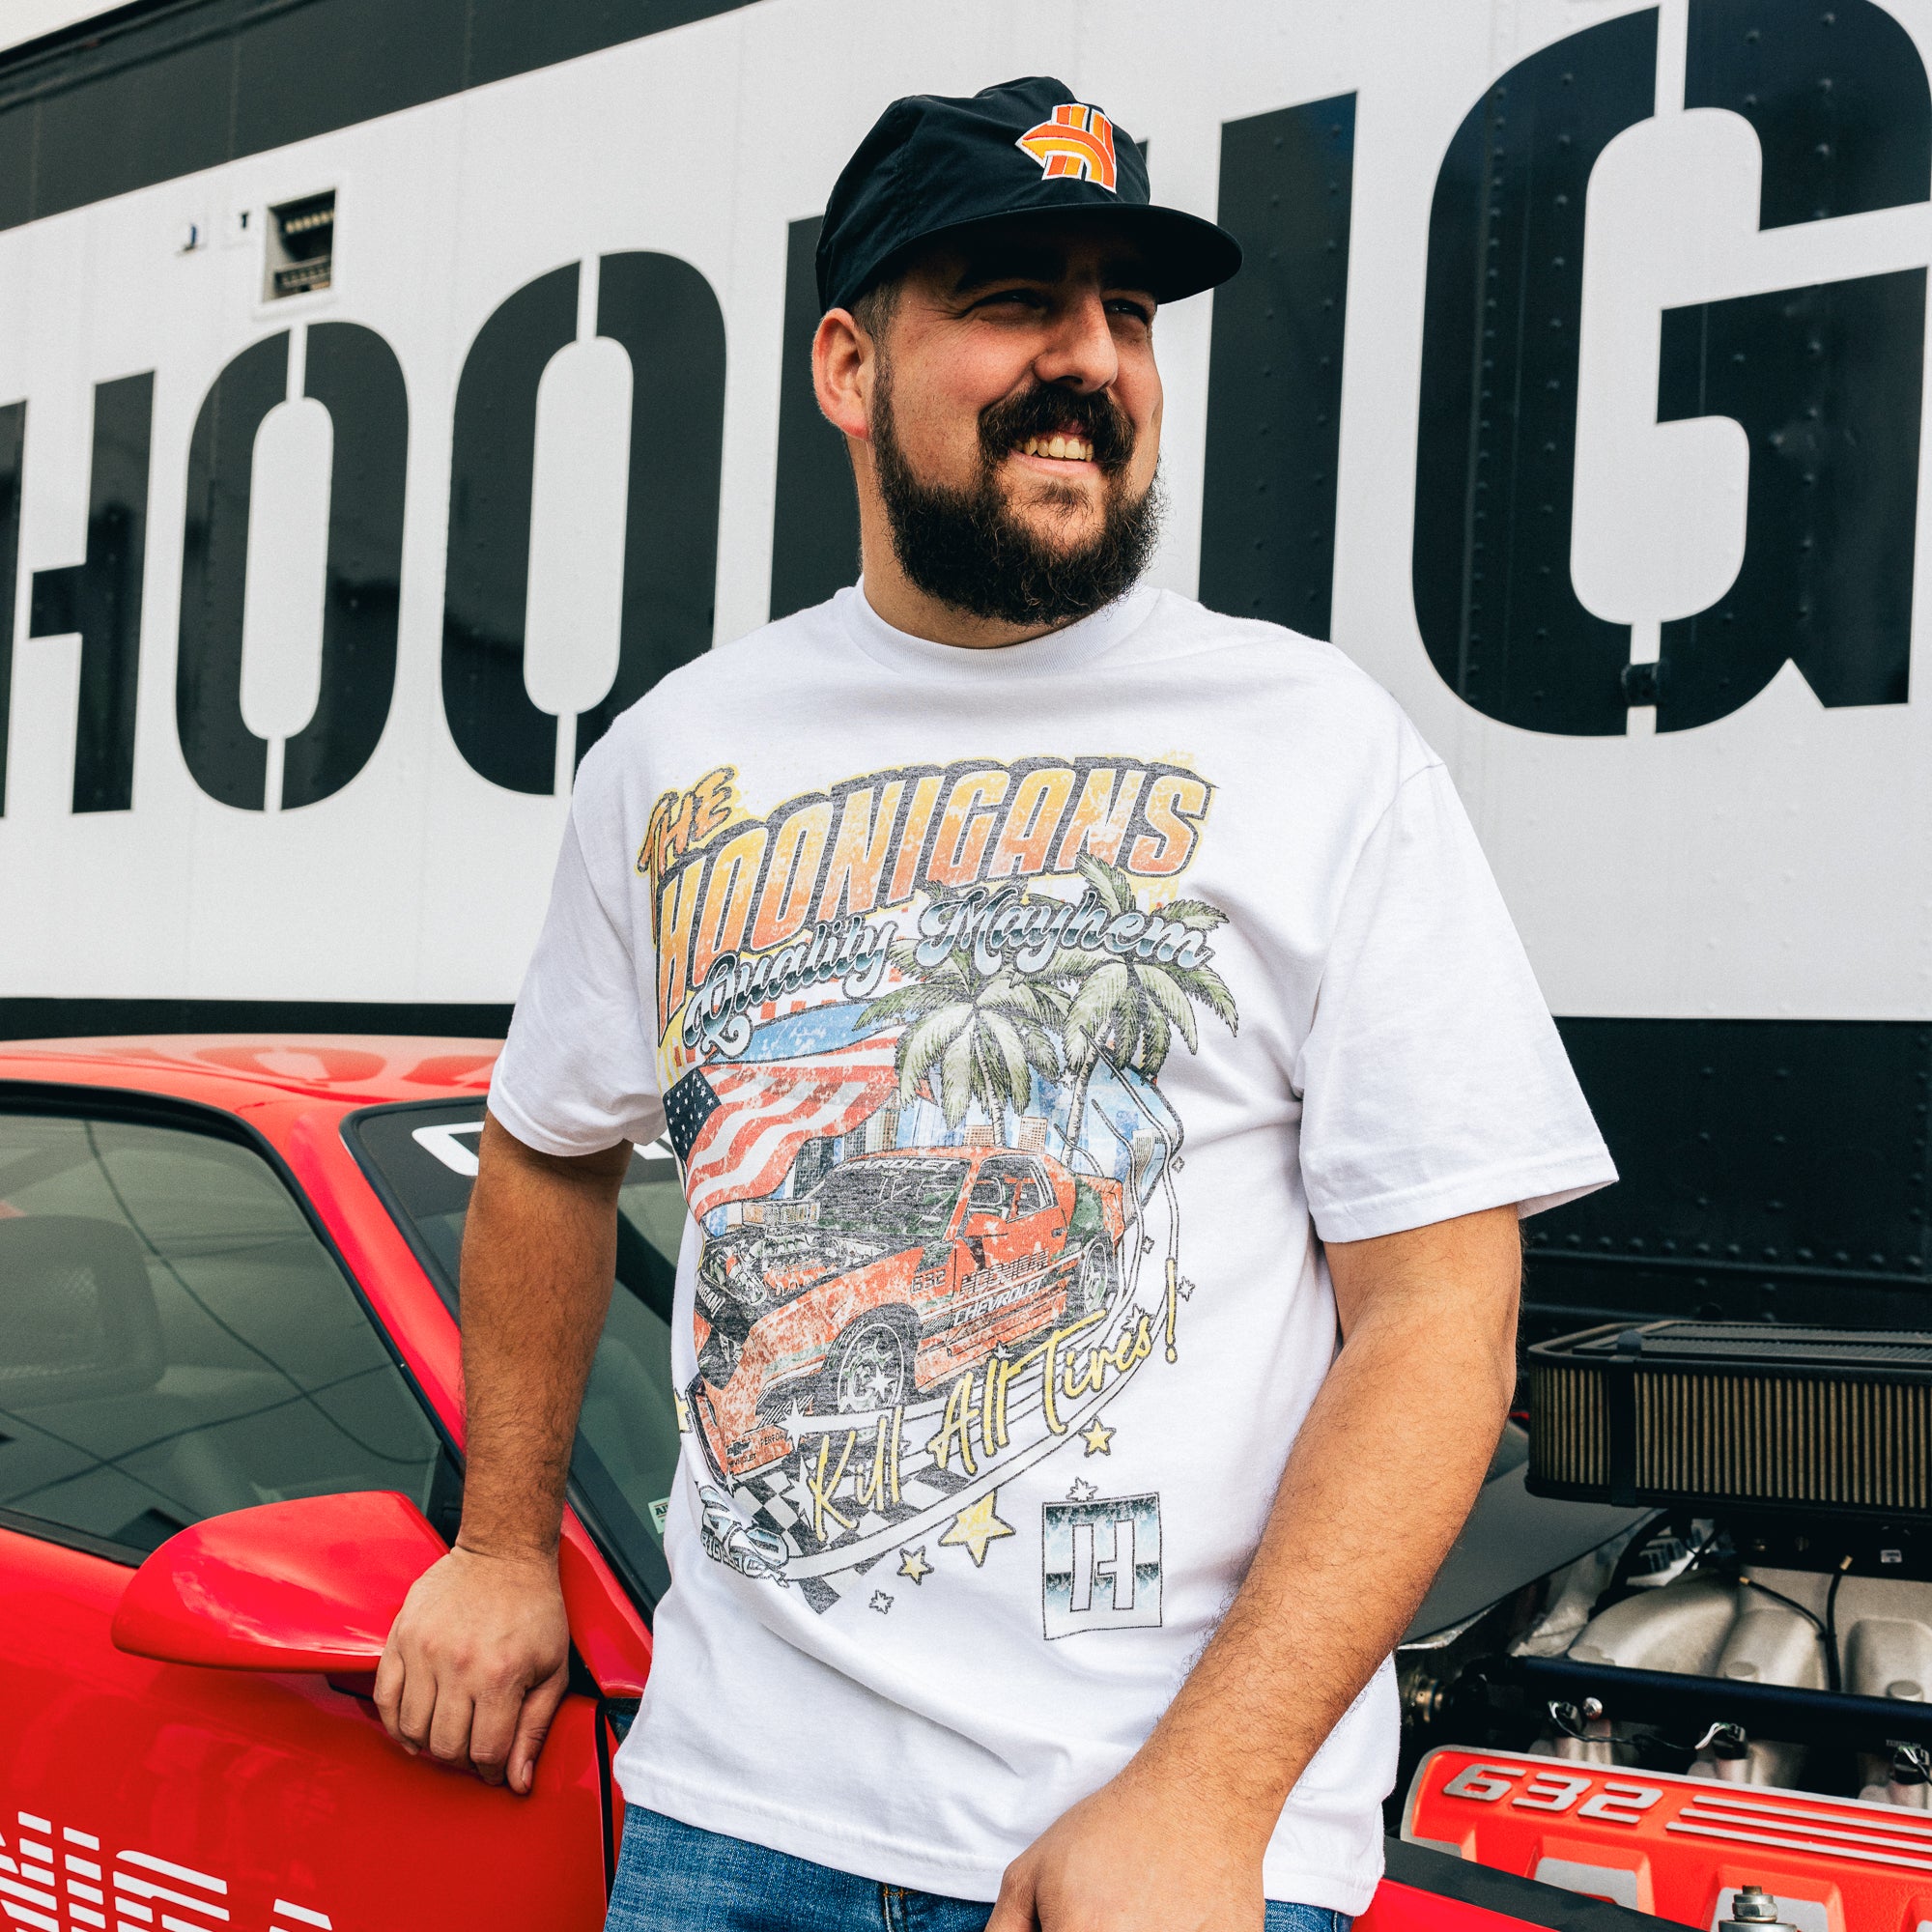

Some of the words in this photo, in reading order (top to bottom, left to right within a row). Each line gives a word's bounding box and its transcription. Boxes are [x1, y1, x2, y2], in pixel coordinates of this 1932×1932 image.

[0, 0, 1932, 816] HOOIG
[638, 767, 734, 880] THE
[657, 756, 1217, 1048] HOONIGANS
[683, 916, 898, 1062] Quality
[916, 884, 1217, 975] Mayhem
[911, 1270, 946, 1293] 632
[953, 1276, 1045, 1326] CHEVROLET
[808, 1404, 905, 1543] Kill
[926, 1355, 1010, 1477] All
[1443, 1763, 1663, 1824] 632
